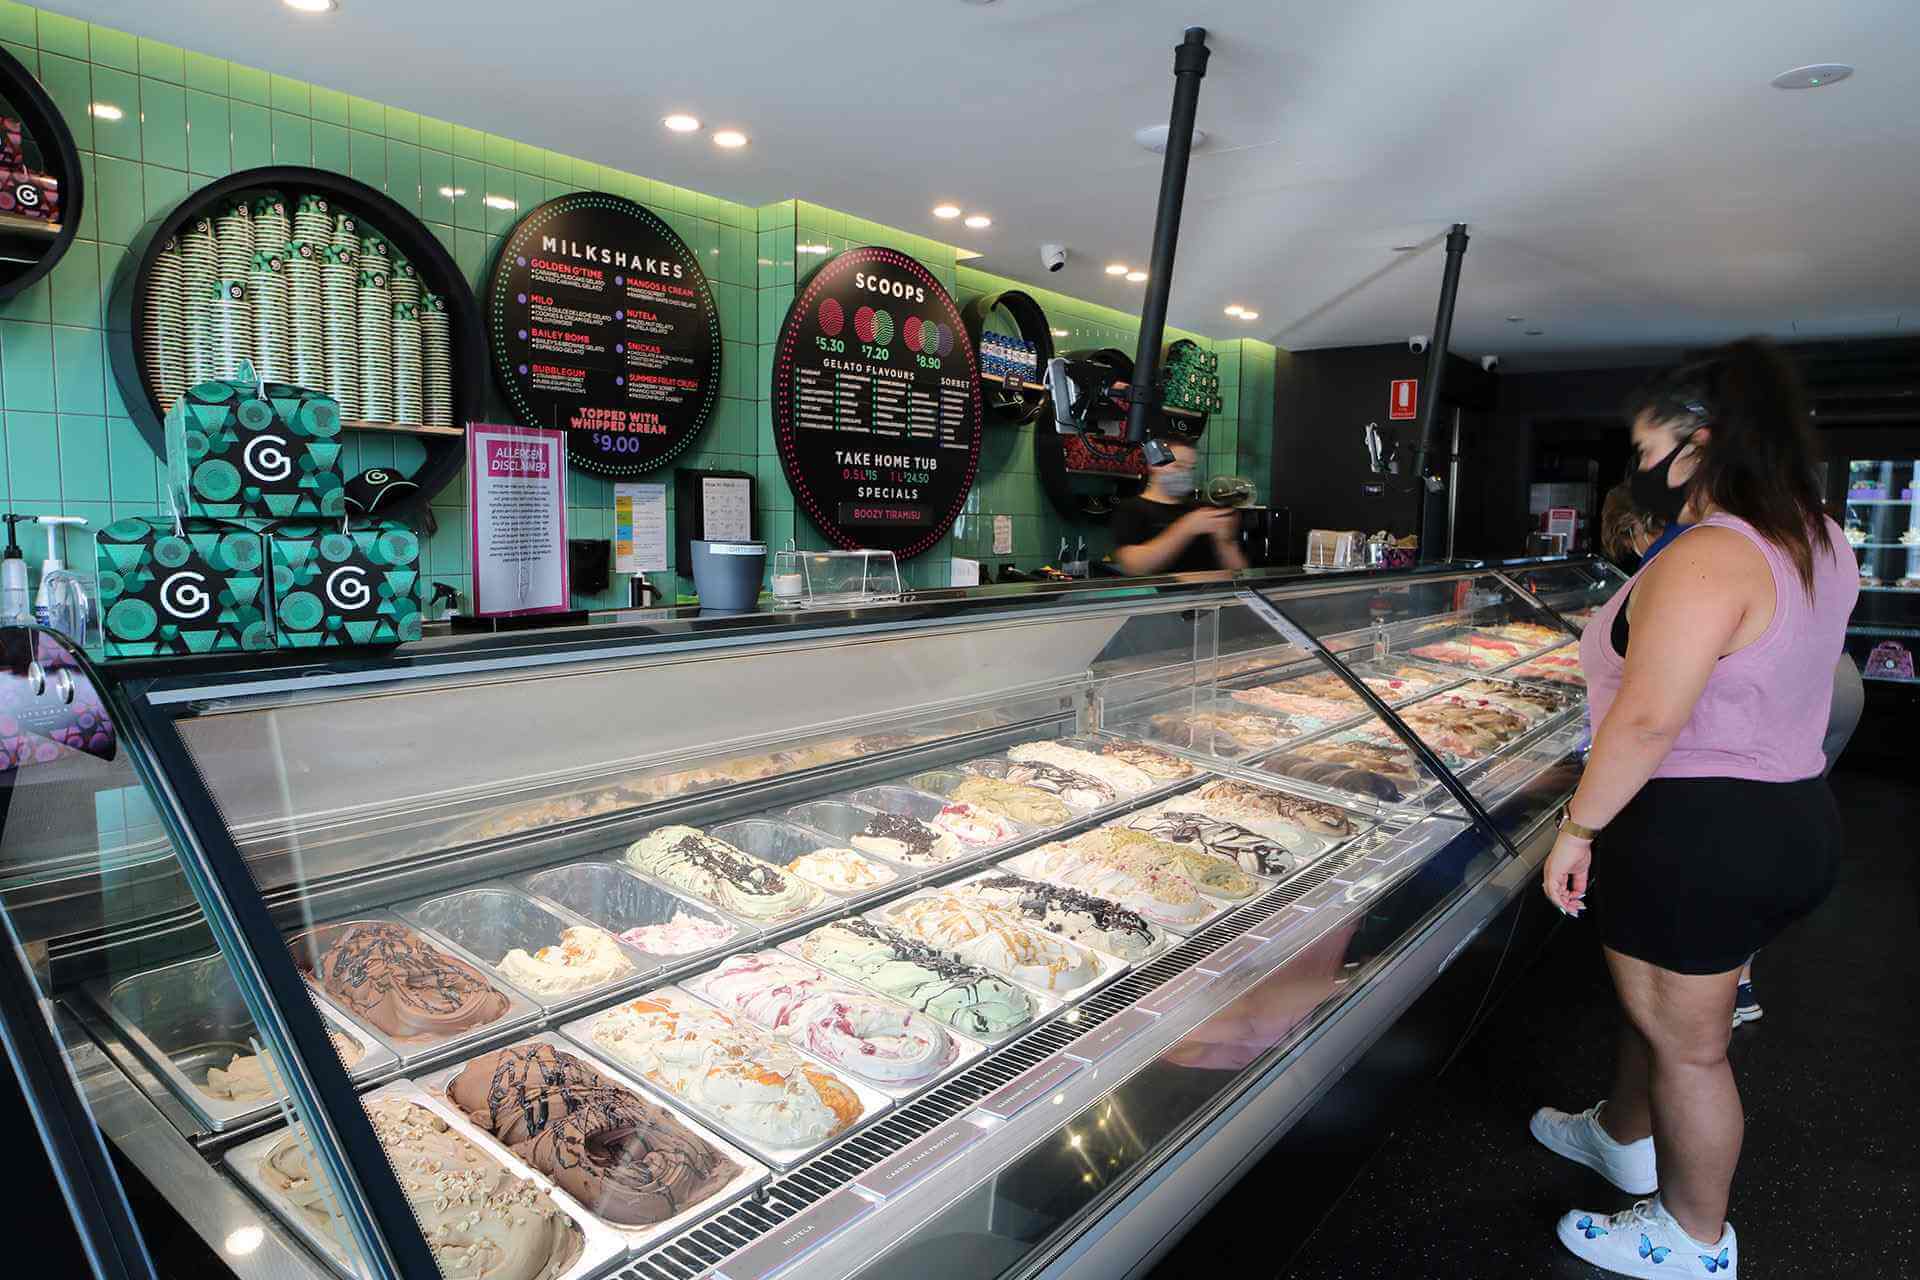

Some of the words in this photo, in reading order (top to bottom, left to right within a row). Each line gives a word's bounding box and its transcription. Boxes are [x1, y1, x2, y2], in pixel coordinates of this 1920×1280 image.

[542, 235, 683, 279] MILKSHAKES
[530, 258, 571, 273] GOLDEN
[626, 277, 661, 291] MANGOS
[667, 286, 694, 297] CREAM
[855, 272, 924, 303] SCOOPS
[530, 294, 554, 305] MILO
[531, 328, 563, 340] BAILEY
[564, 332, 590, 344] BOMB
[816, 336, 845, 353] $5.30
[862, 344, 889, 360] $7.20
[823, 358, 863, 372] GELATO
[866, 365, 914, 380] FLAVOURS
[916, 354, 941, 370] $8.90
[532, 364, 586, 377] BUBBLEGUM
[628, 374, 658, 384] SUMMER
[941, 377, 970, 389] SORBET
[579, 407, 626, 421] TOPPED
[629, 412, 659, 424] WITH
[570, 417, 626, 432] WHIPPED
[628, 423, 667, 434] CREAM
[592, 433, 640, 453] $9.00
[496, 447, 542, 461] ALLERGEN
[834, 450, 871, 466] TAKE
[874, 454, 910, 469] HOME
[914, 456, 937, 470] TUB
[857, 486, 919, 500] SPECIALS
[853, 508, 883, 519] BOOZY
[885, 509, 921, 520] TIRAMISU
